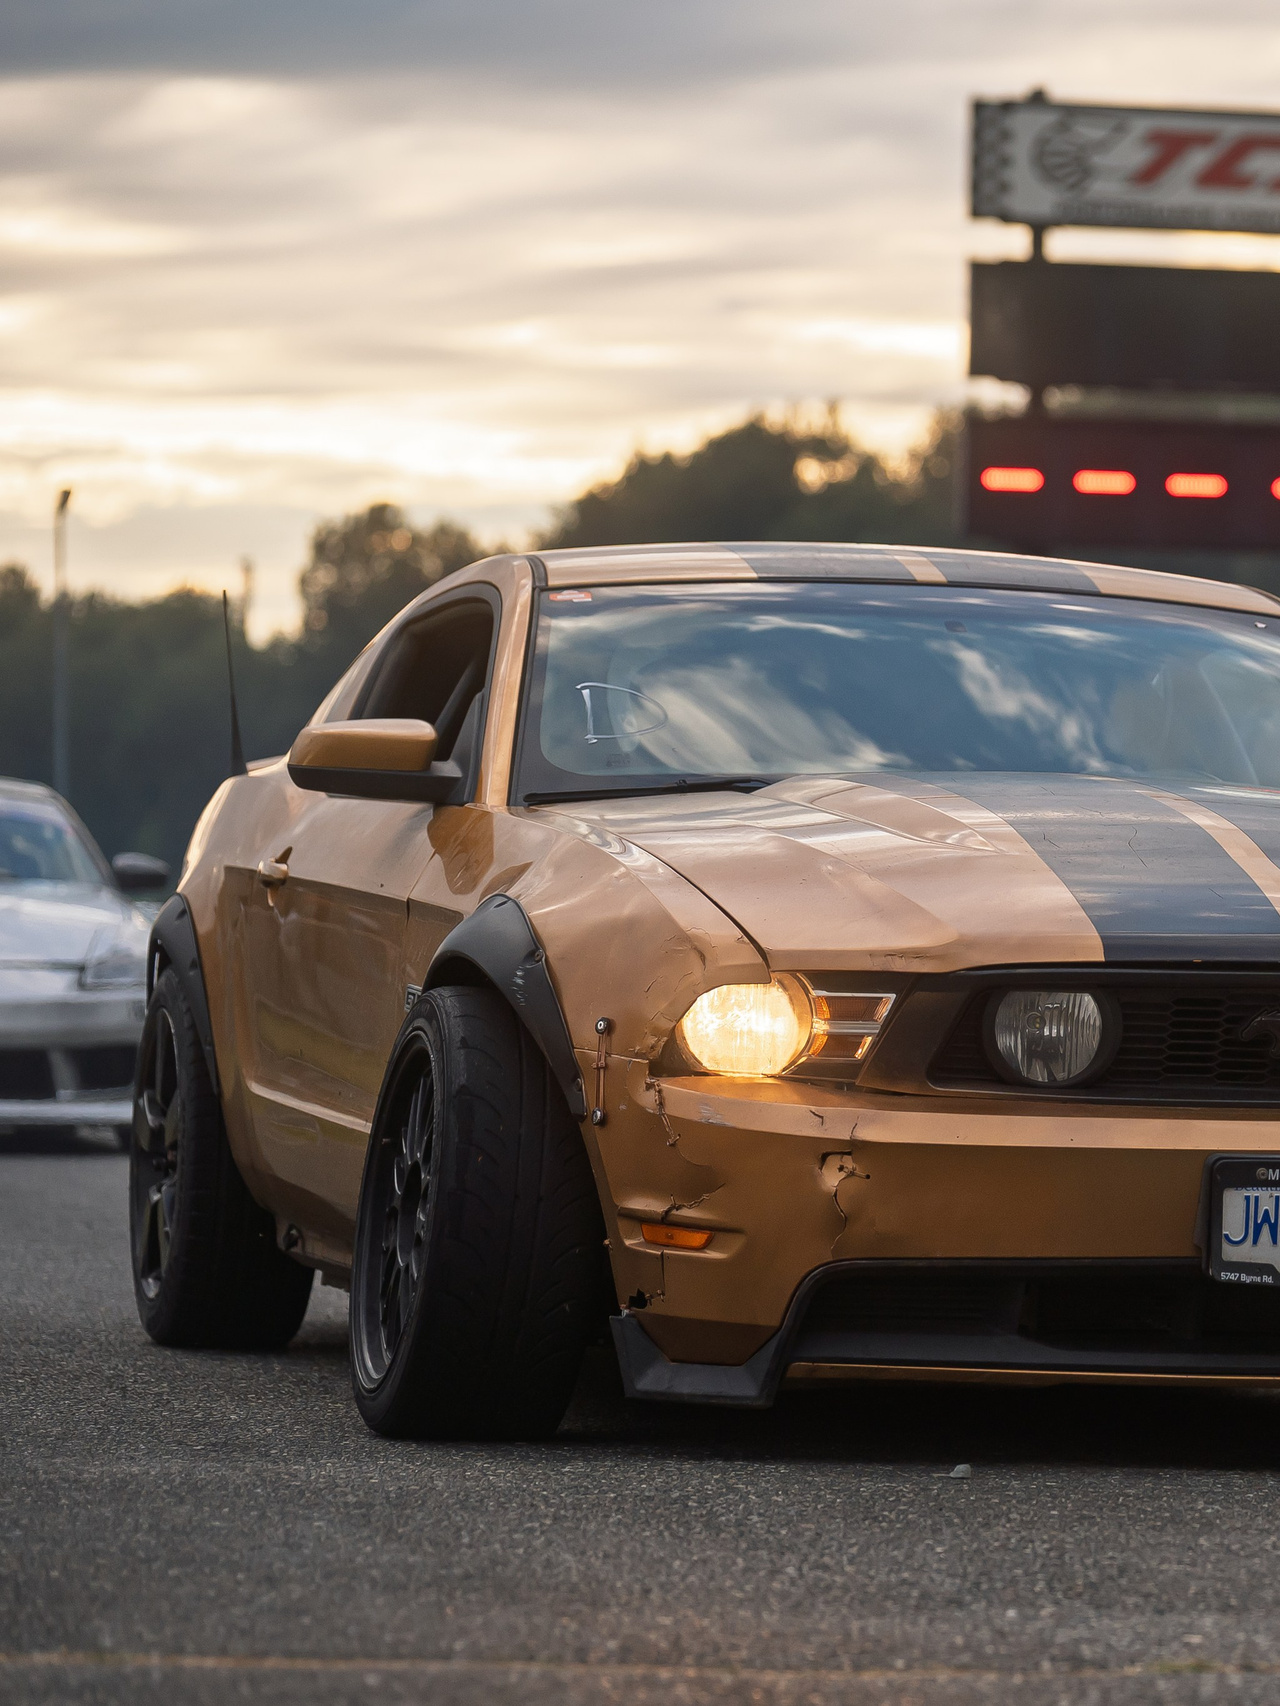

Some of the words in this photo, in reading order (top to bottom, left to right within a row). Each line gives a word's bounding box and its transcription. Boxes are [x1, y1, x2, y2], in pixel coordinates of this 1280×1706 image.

[1220, 1271, 1240, 1281] 5747
[1240, 1273, 1262, 1283] Byrne
[1262, 1274, 1274, 1284] Rd.
